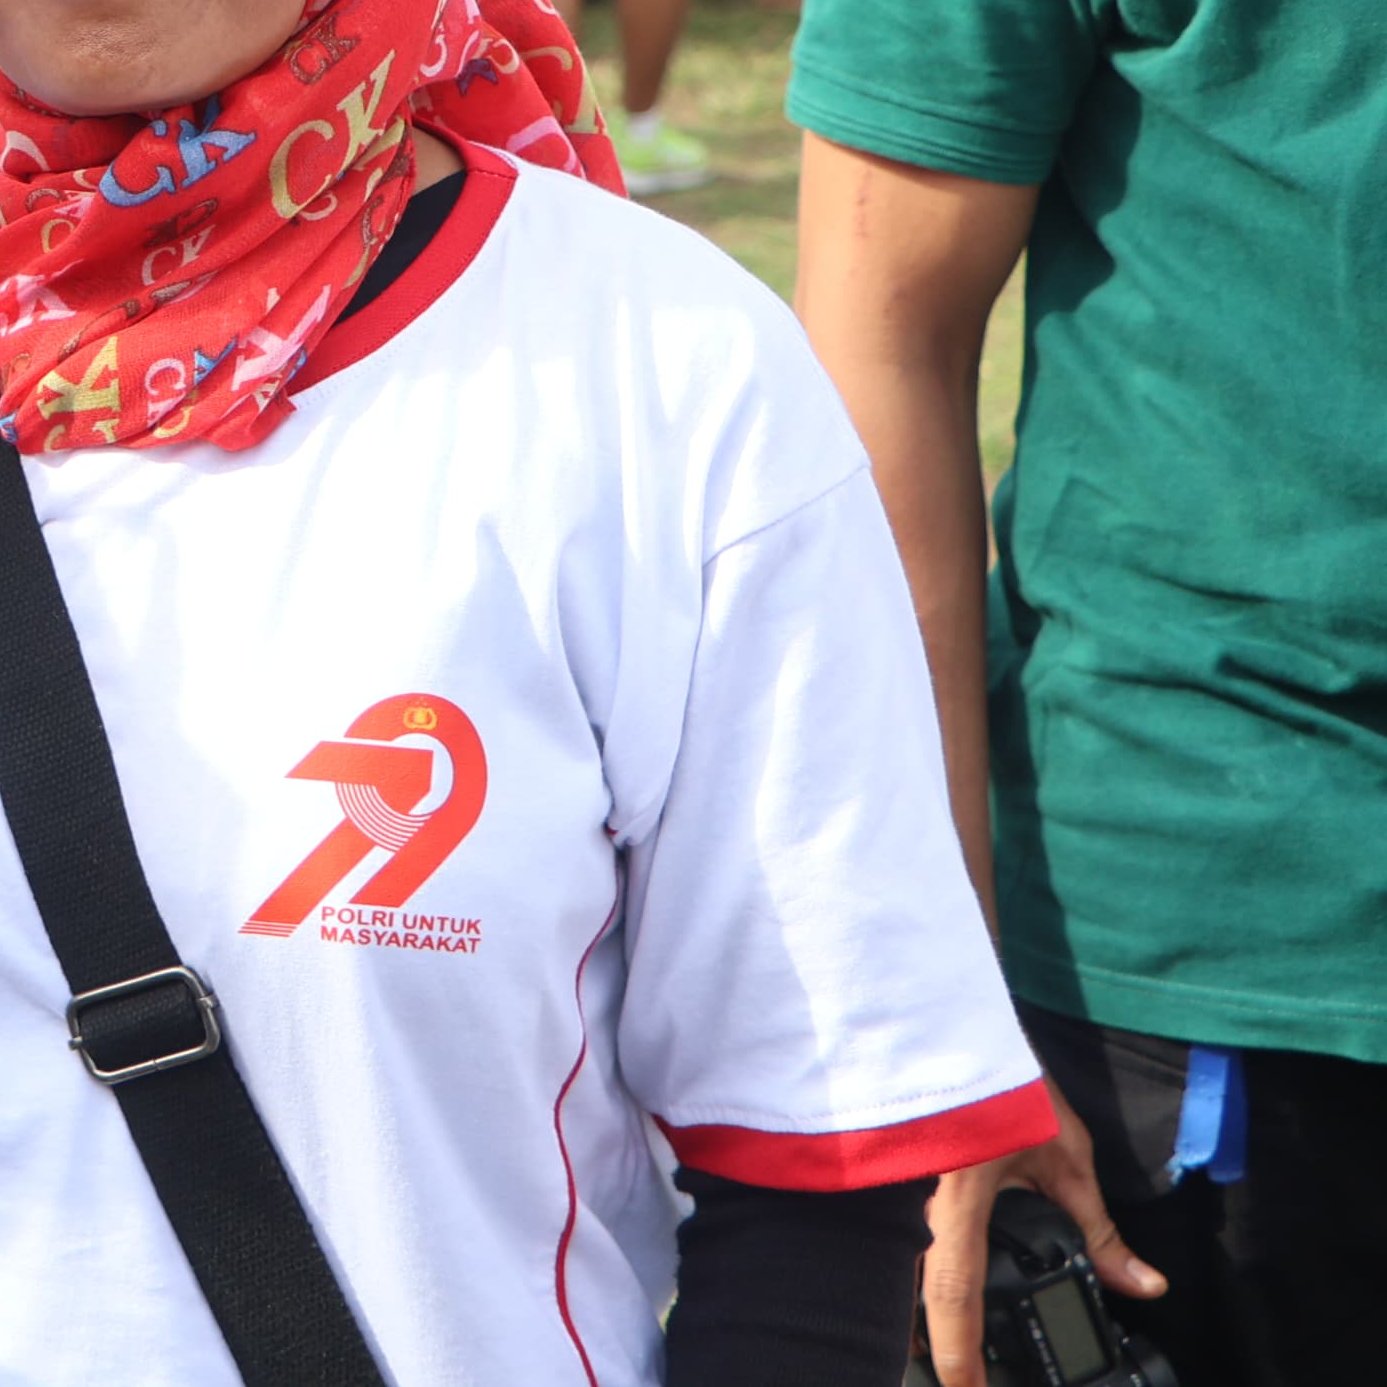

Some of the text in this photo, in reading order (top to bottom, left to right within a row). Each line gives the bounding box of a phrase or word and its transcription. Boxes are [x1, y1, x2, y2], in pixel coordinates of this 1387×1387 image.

[98, 92, 258, 207] CK
[268, 48, 396, 219] CK
[320, 905, 482, 935] POLRI UNTUK
[320, 925, 482, 954] MASYARAKAT
